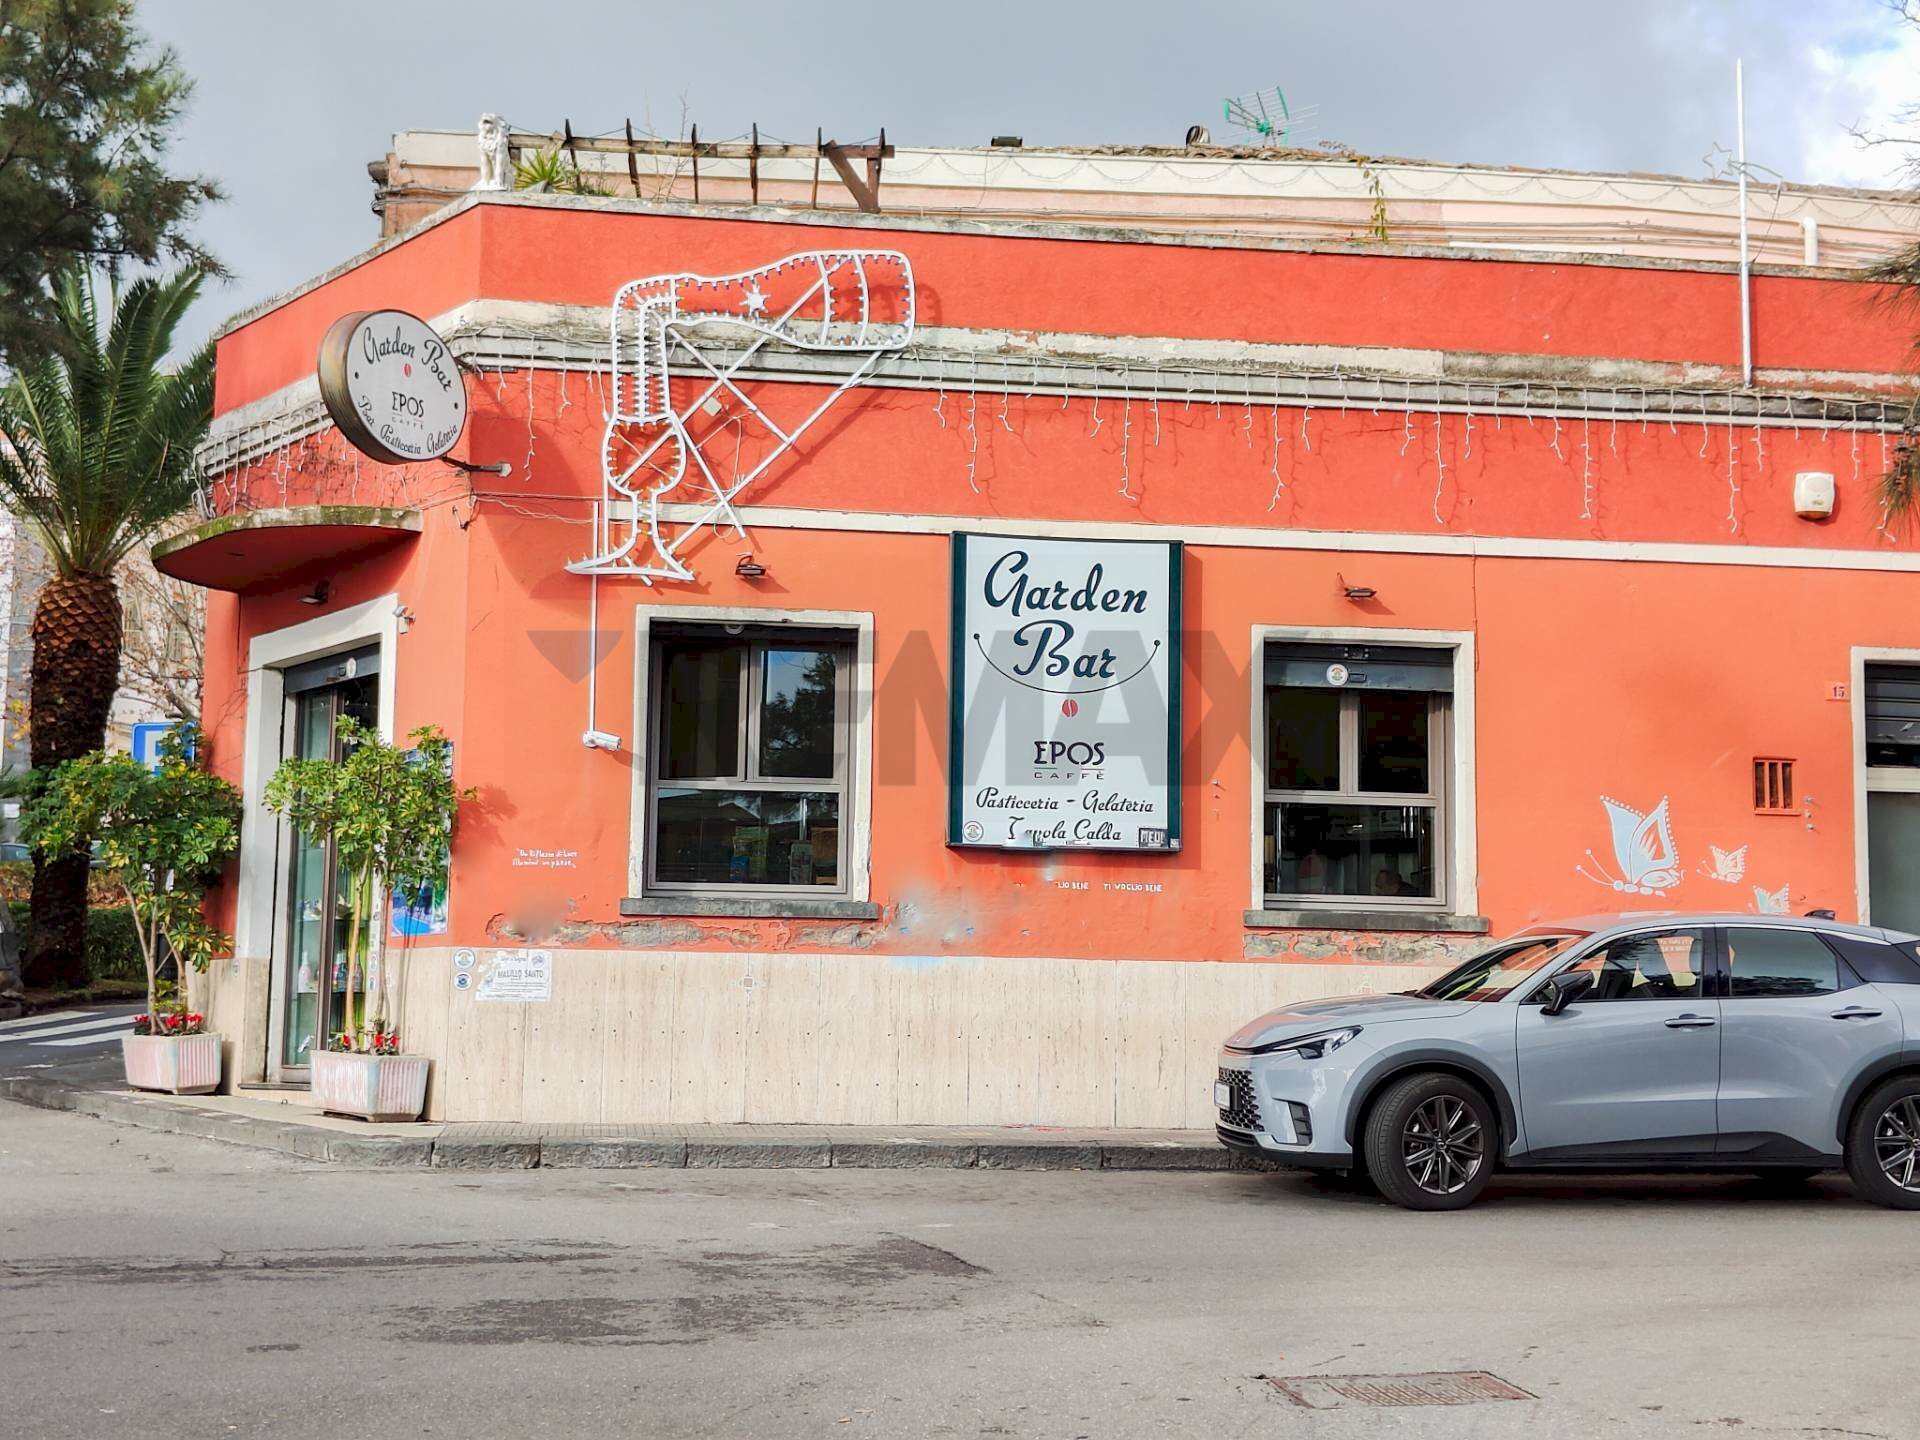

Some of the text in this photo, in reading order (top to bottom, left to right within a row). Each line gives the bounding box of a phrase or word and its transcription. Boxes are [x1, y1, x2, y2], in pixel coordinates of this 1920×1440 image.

[363, 325, 453, 392] Garden Bar
[391, 391, 424, 418] EPOS
[358, 395, 458, 455] Bar Pasticceria Gelateria
[984, 550, 1148, 617] Garden
[1013, 619, 1117, 679] Bar
[1833, 686, 1845, 697] 15
[1033, 740, 1105, 766] EPOS
[1034, 770, 1105, 780] CAFFÈ
[976, 786, 1059, 810] Pasticceria
[1082, 789, 1154, 814] Gelateria
[1073, 818, 1122, 841] Calda
